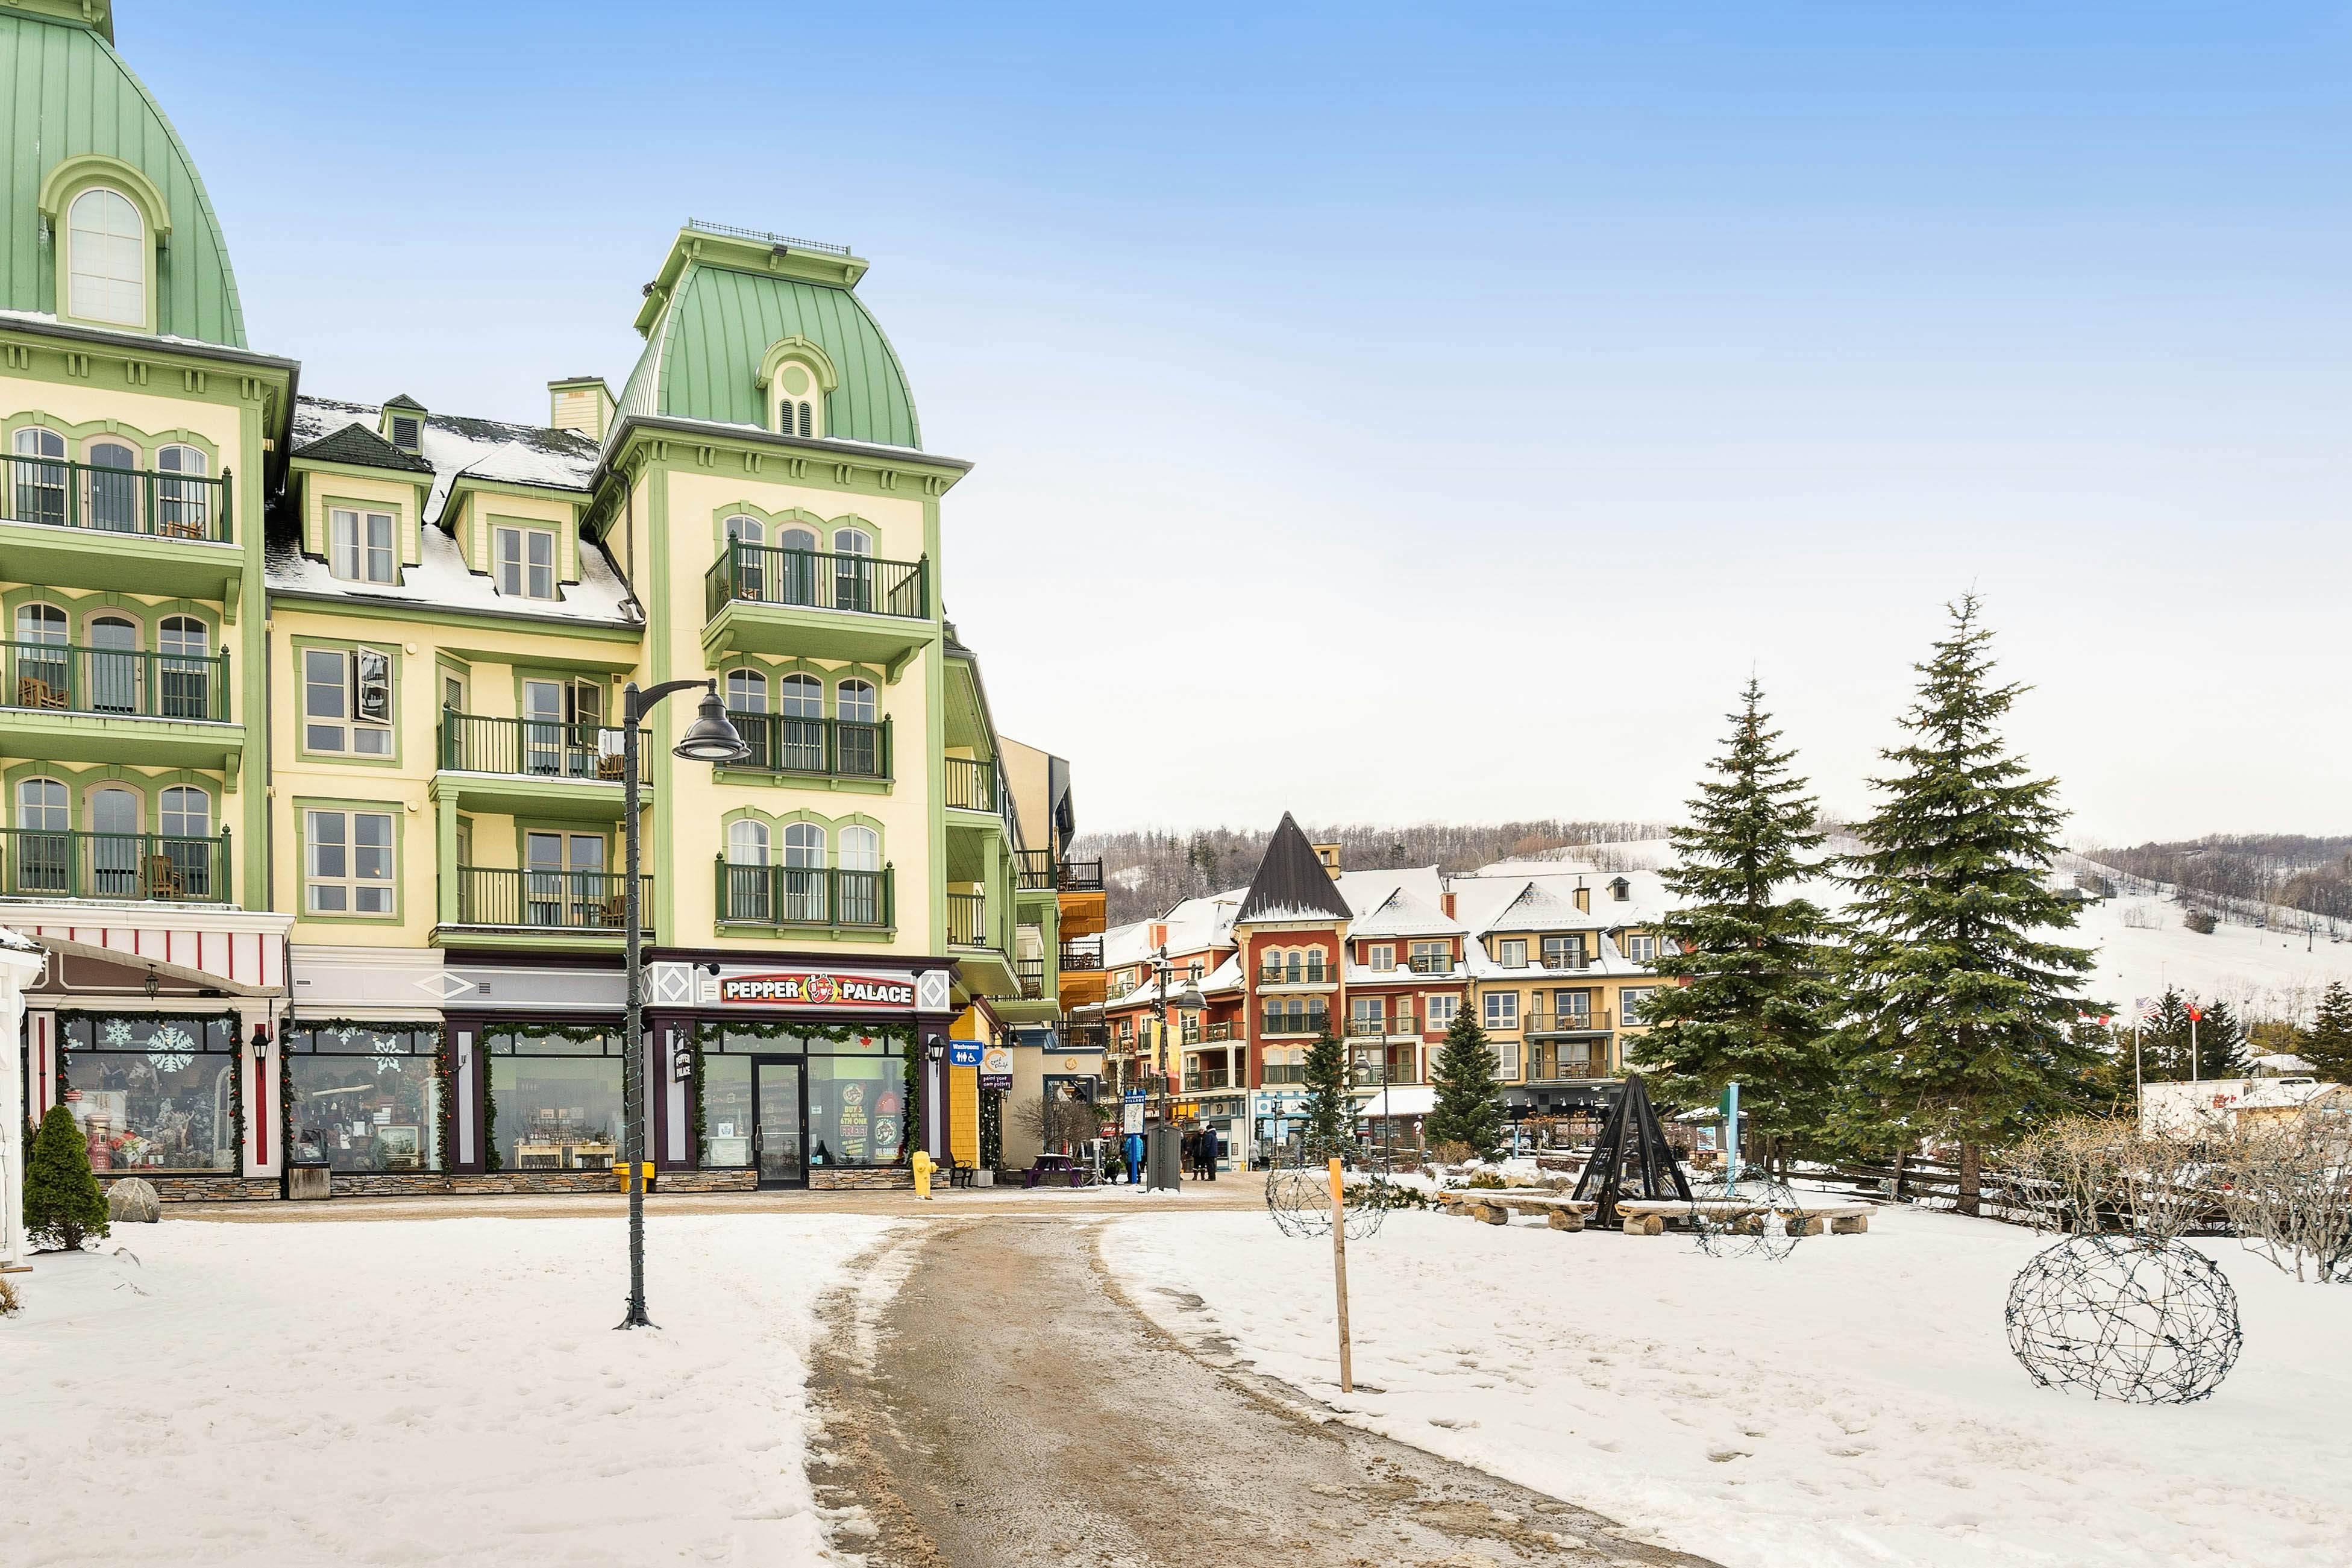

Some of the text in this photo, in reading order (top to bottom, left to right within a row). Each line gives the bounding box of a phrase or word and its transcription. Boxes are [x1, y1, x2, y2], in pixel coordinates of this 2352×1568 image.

[726, 981, 912, 1003] PEPPER PALACE
[676, 1053, 691, 1067] PEPPER
[676, 1066, 691, 1077] PALACE
